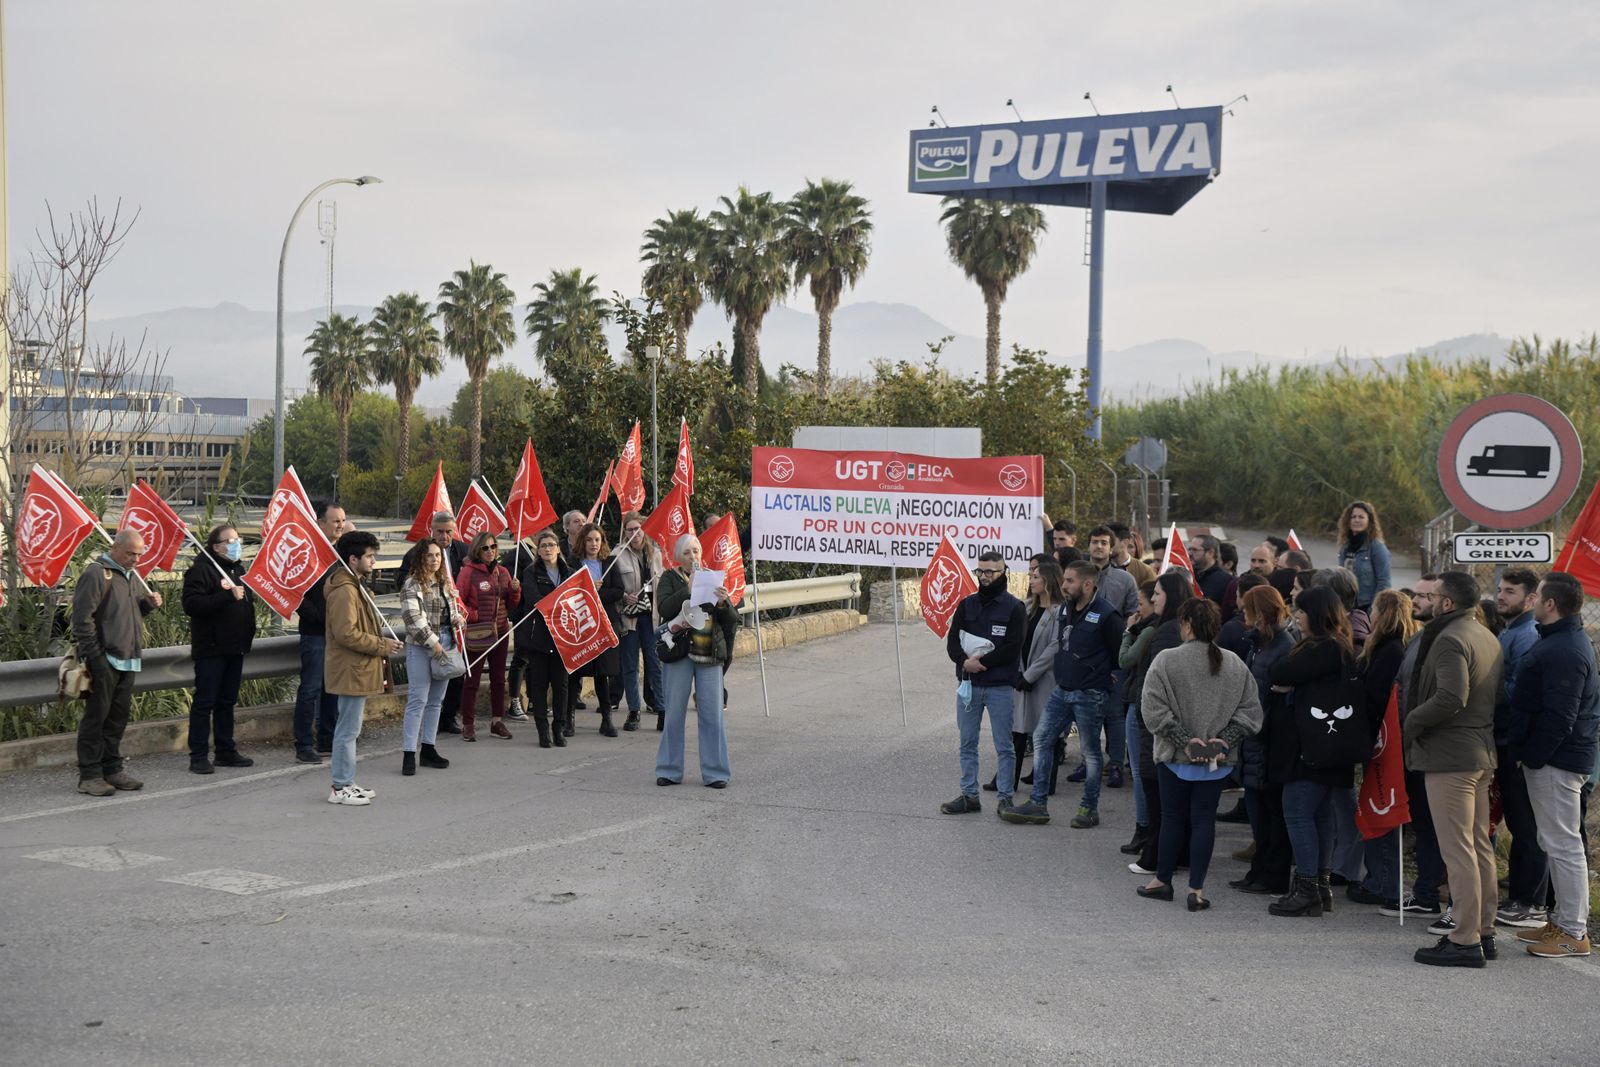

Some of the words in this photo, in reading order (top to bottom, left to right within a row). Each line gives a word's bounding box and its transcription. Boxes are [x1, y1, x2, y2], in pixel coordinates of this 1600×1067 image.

[920, 145, 965, 158] PULEVA
[973, 122, 1212, 183] PULEVA
[835, 459, 883, 481] UGT
[918, 464, 954, 478] FICA
[764, 493, 832, 512] LACTALIS
[836, 496, 891, 514] PULEVA
[896, 497, 1004, 519] ¡NEGOCIACIÓN
[1009, 502, 1031, 520] YA!
[803, 518, 838, 533] POR
[843, 521, 865, 534] UN
[871, 521, 959, 538] CONVENIO
[964, 525, 1001, 540] CON
[269, 527, 304, 578] UGT
[758, 534, 816, 552] JUSTICIA
[819, 537, 887, 558] SALARIAL,
[1465, 538, 1540, 546] EXCEPTO
[1469, 550, 1534, 558] GRELVA
[567, 593, 597, 634] UGT
[571, 636, 610, 662] www.ugt.es
